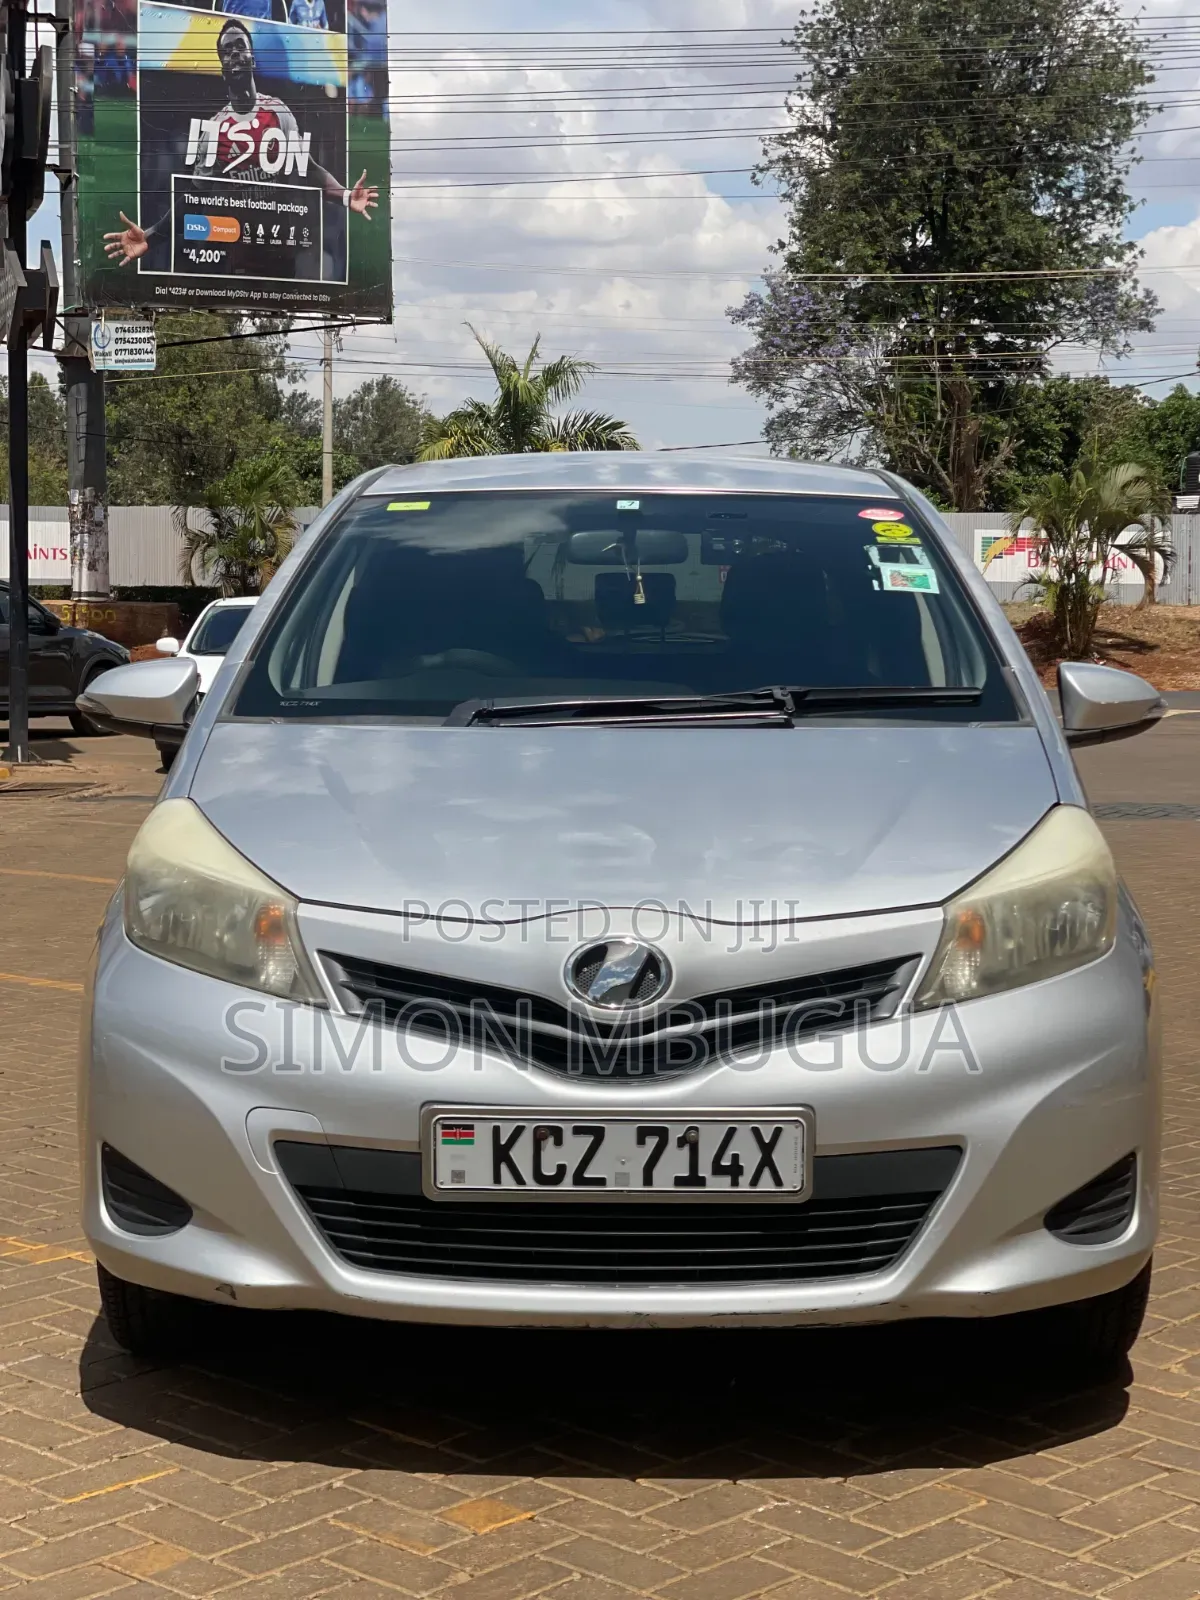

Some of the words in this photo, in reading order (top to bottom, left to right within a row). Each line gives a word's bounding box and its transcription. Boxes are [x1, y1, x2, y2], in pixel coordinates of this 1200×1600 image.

[259, 127, 311, 177] ON
[184, 193, 199, 204] The
[200, 195, 229, 207] world's
[230, 197, 247, 208] best
[248, 199, 276, 211] football
[277, 203, 308, 216] package
[186, 224, 207, 232] DStv
[212, 226, 237, 234] Compact
[189, 249, 221, 264] 4,200
[155, 286, 168, 295] Dial
[195, 288, 226, 297] Download
[227, 289, 249, 299] MyDStv
[249, 290, 261, 301] App
[262, 291, 269, 299] to
[269, 291, 282, 301] stay
[282, 292, 312, 301] Connected
[312, 293, 318, 301] to
[318, 294, 331, 302] DStv
[491, 1124, 607, 1187] KCZ
[636, 1124, 784, 1187] 714X
